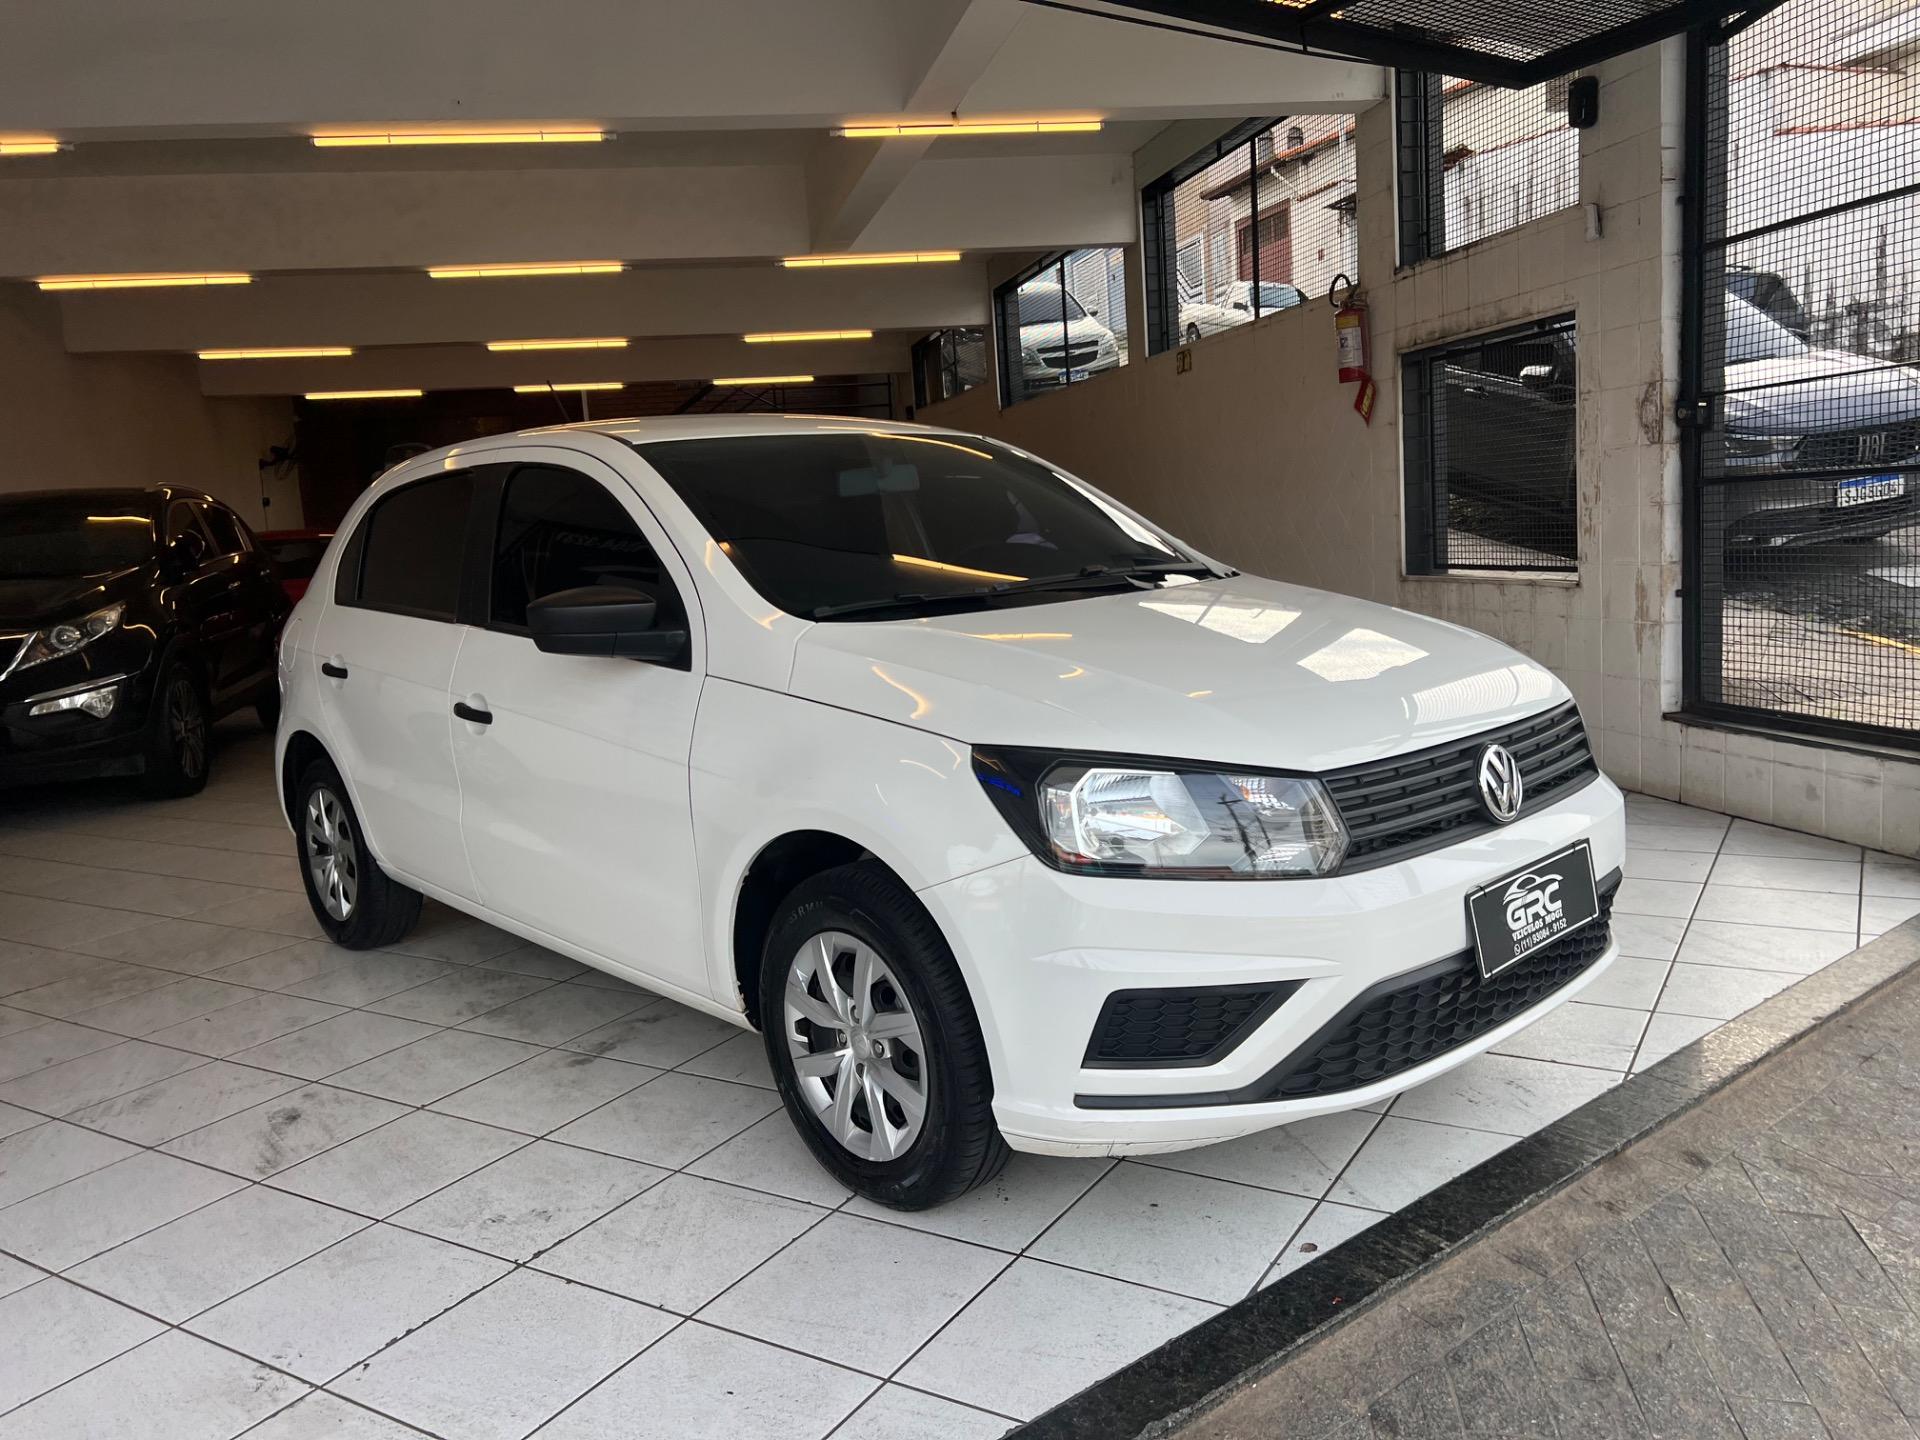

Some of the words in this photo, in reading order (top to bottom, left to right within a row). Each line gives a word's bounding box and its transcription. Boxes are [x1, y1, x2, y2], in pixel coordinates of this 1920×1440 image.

[1506, 880, 1562, 930] GRC
[1512, 918, 1544, 942] VEICULOS
[1544, 908, 1563, 925] MOGI
